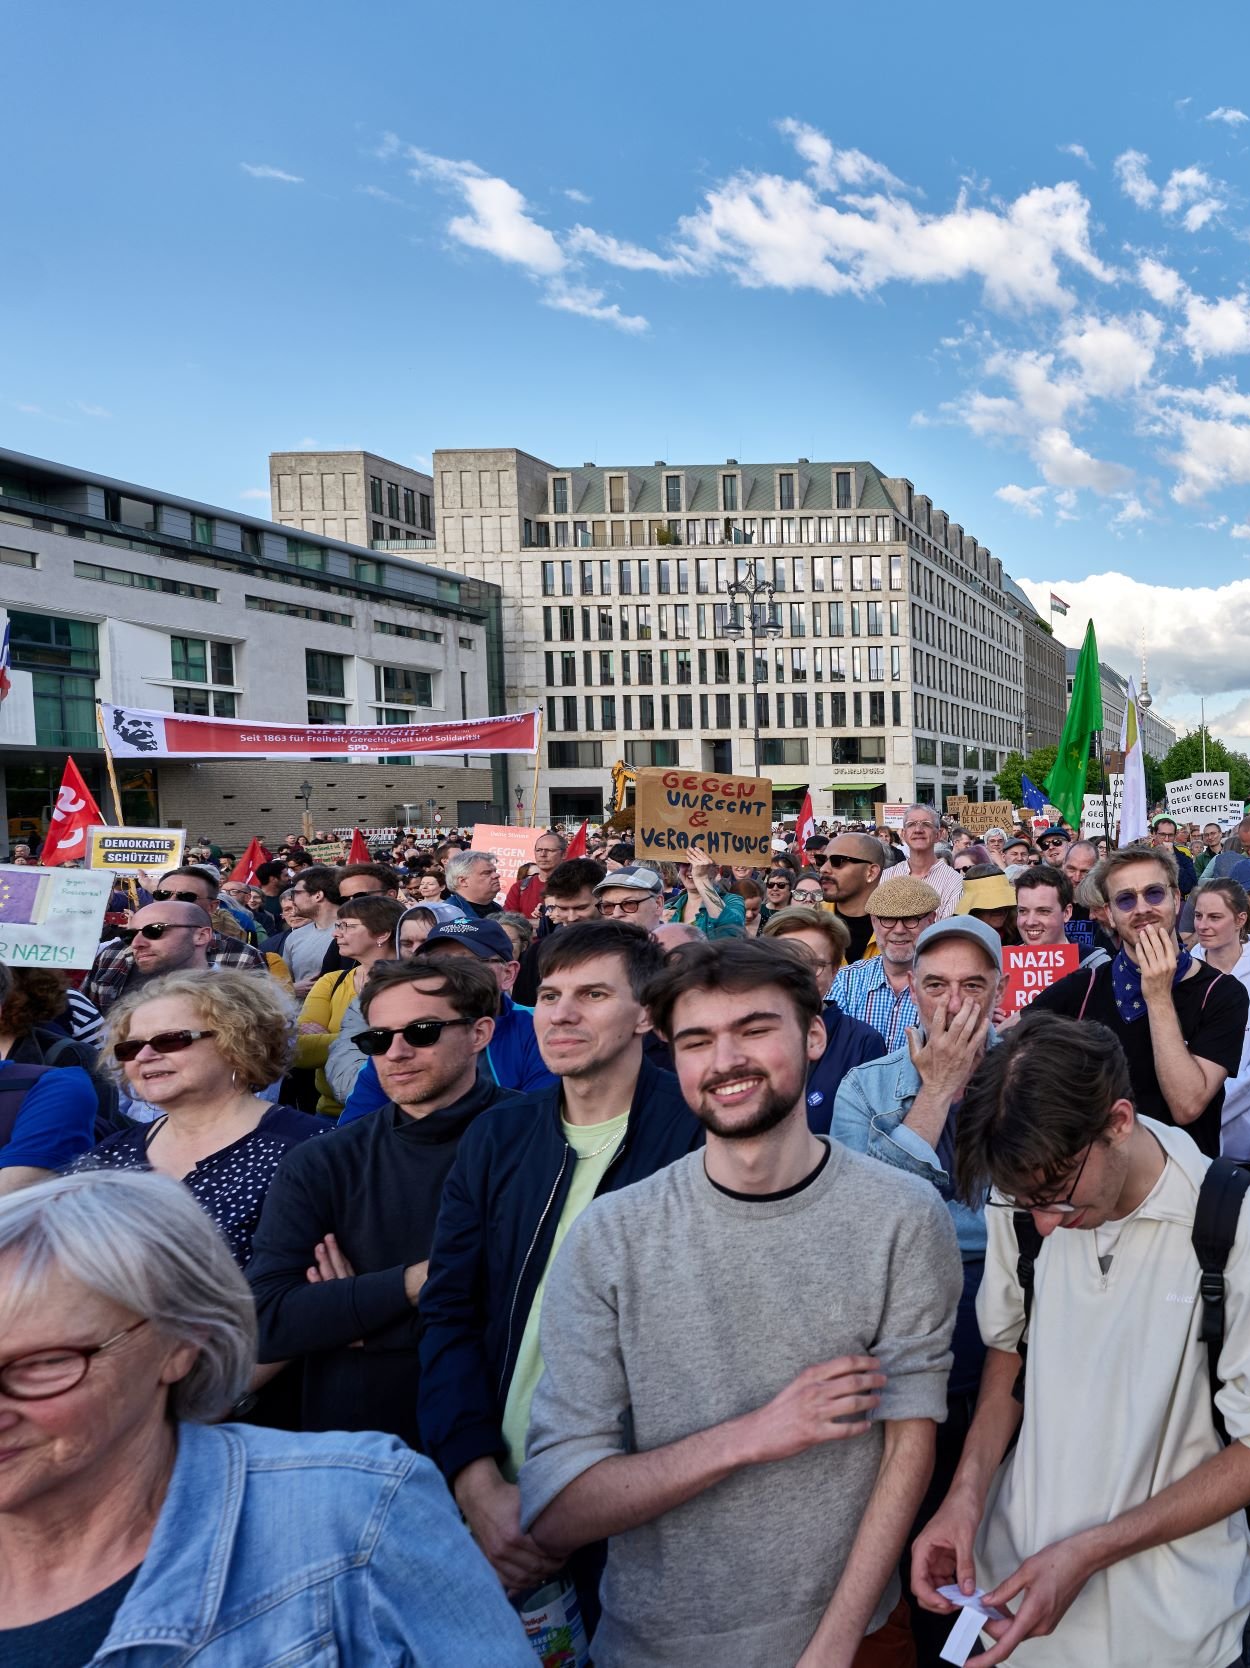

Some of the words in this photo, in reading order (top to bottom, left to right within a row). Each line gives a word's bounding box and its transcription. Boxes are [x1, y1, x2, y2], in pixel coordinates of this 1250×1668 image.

[240, 734, 261, 743] Seit
[263, 735, 286, 743] 1863
[288, 734, 304, 743] für
[307, 734, 348, 744] Freiheit,
[350, 735, 413, 745] Gerechtigkeit
[435, 734, 480, 742] Solidarität
[662, 771, 756, 800] GEGEN
[1196, 779, 1225, 787] OMAS
[1171, 794, 1193, 805] GEGE
[1194, 792, 1226, 800] GEGEN
[666, 789, 767, 816] UNRECHT
[962, 804, 987, 815] NAZIS
[989, 805, 1008, 815] VON
[1172, 806, 1193, 816] RECH
[688, 811, 709, 827] &
[104, 839, 171, 849] DEMOKRATIE
[641, 827, 770, 854] VERACHTUNG
[107, 852, 165, 863] SCHÜTZEN!
[489, 847, 526, 857] GEGEN
[12, 943, 75, 963] NAZIS!
[1009, 950, 1065, 969] NAZIS
[1023, 970, 1054, 987] DIE
[1015, 989, 1044, 1007] RO
